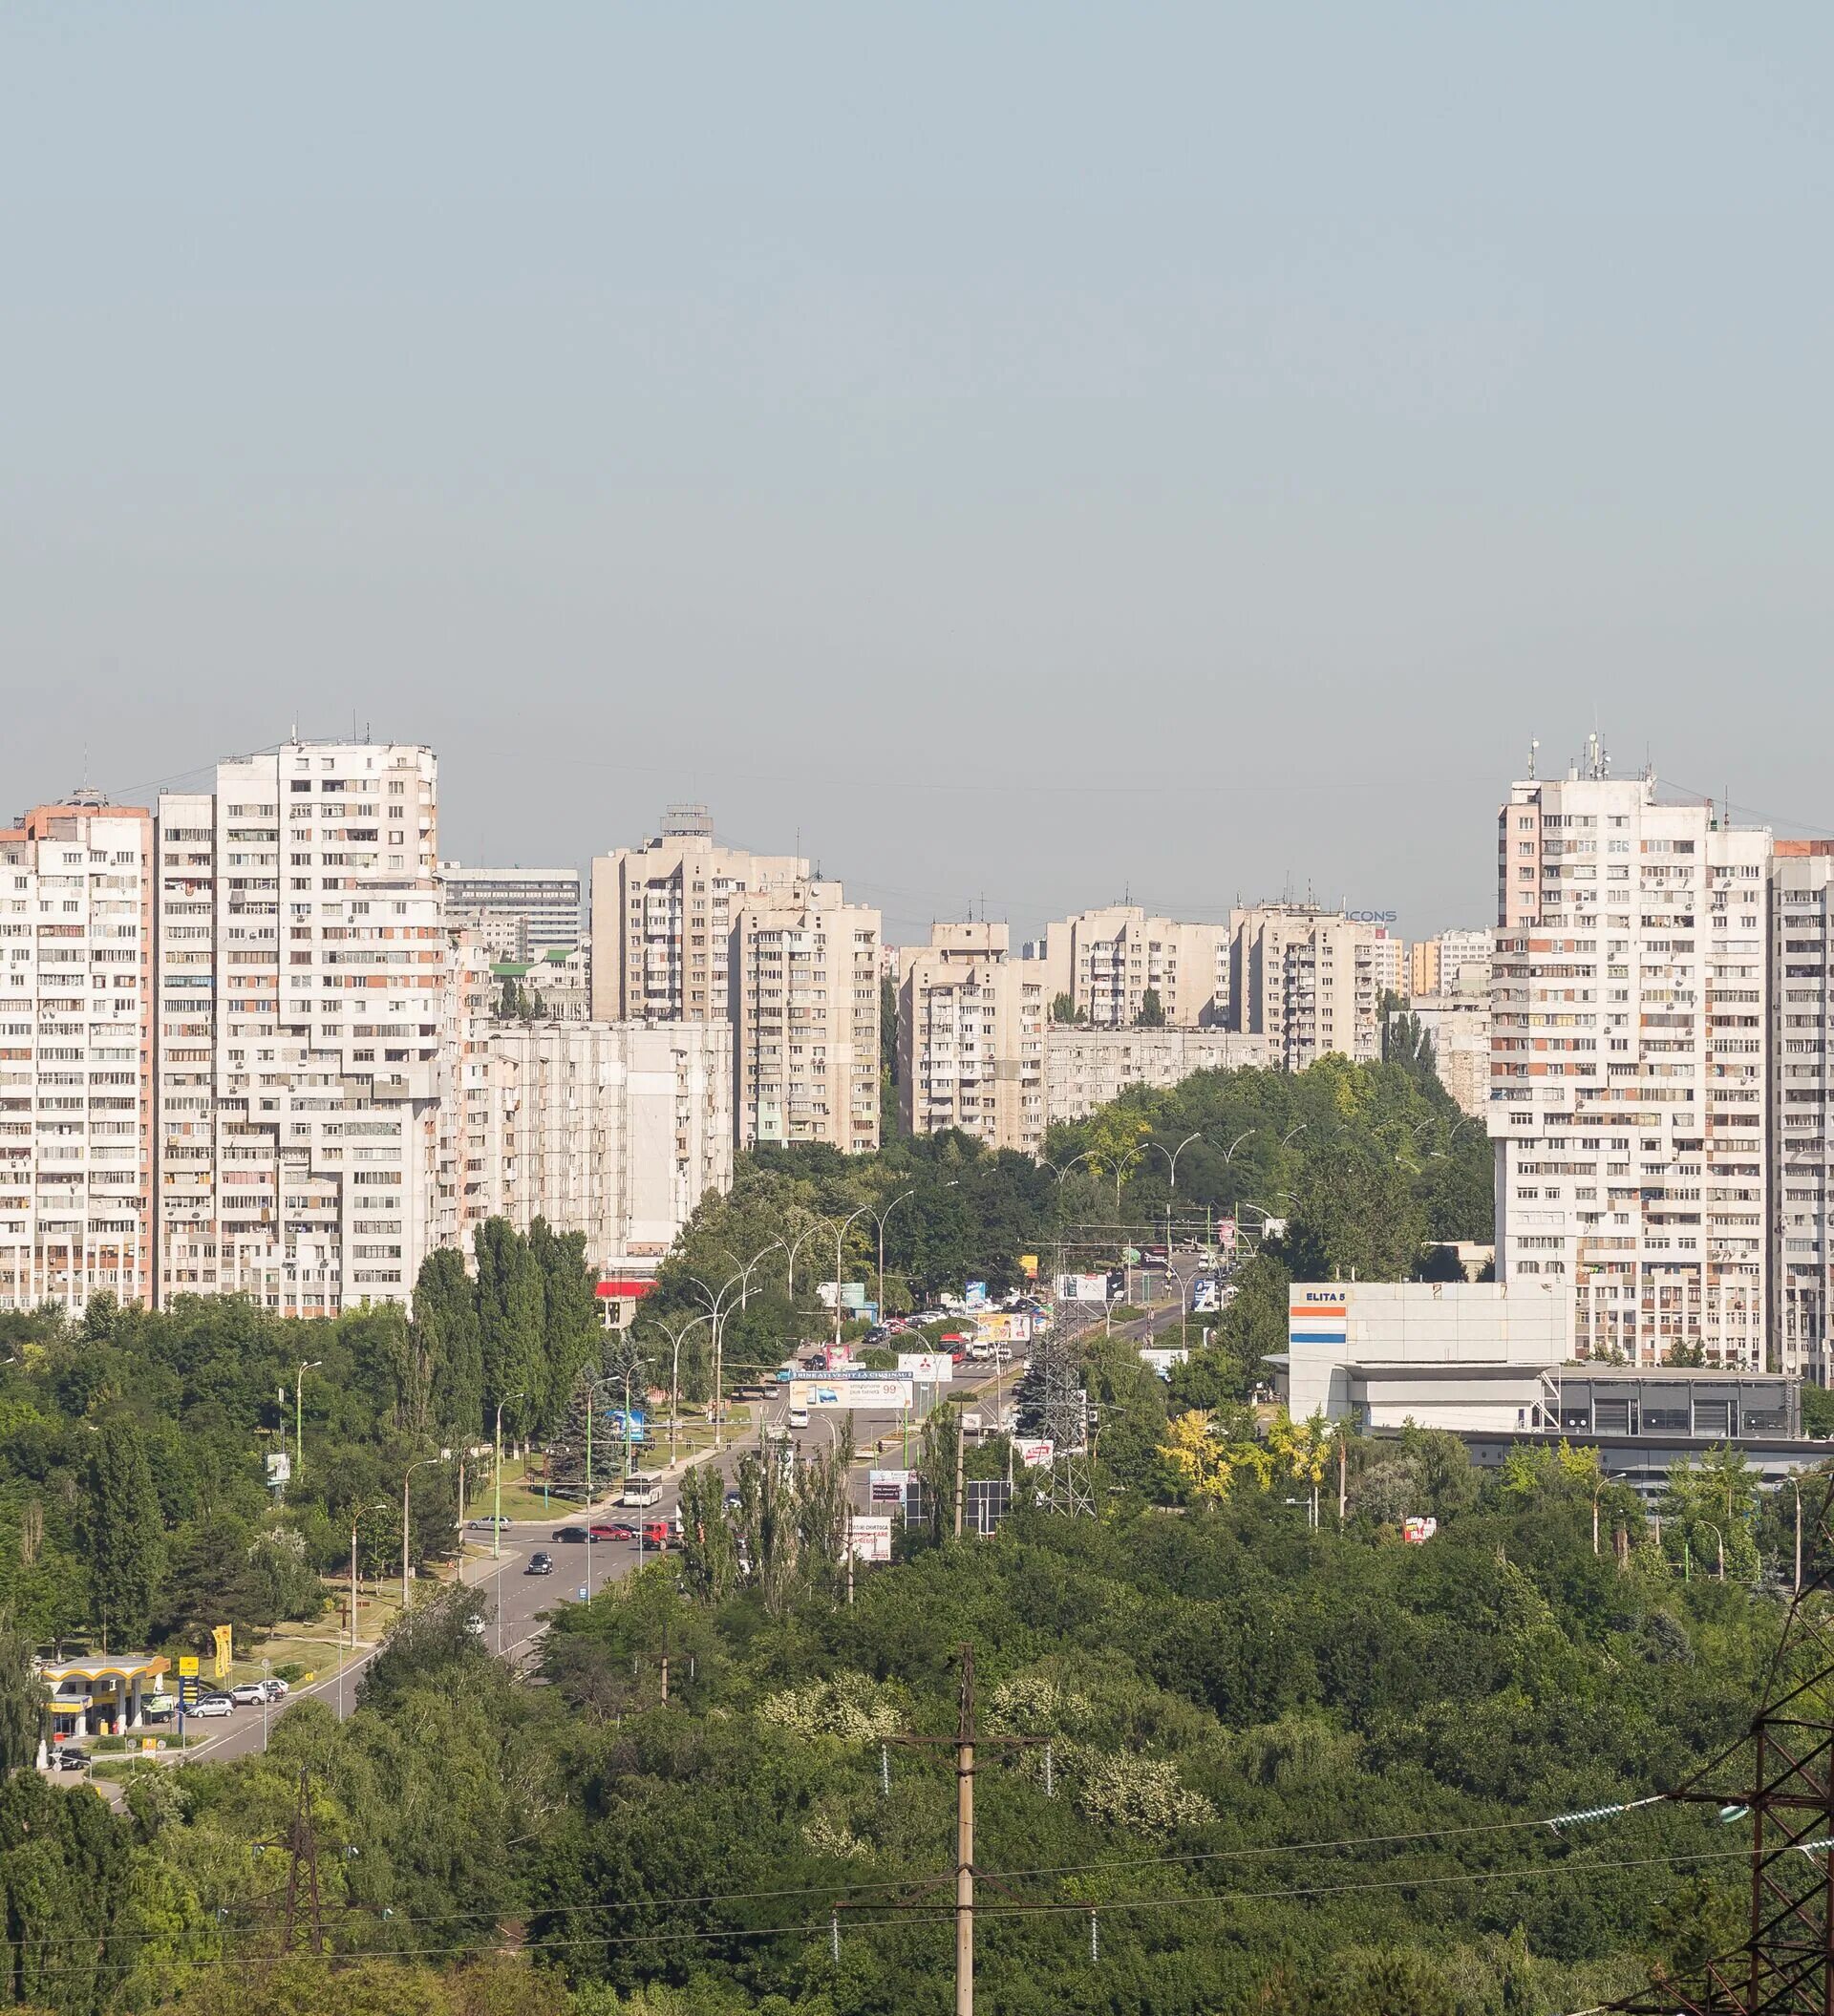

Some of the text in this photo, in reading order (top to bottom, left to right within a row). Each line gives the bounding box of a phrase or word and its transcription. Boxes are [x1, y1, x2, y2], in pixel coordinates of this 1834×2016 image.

[1306, 1292, 1346, 1302] ELITA 5
[883, 1384, 897, 1394] 99
